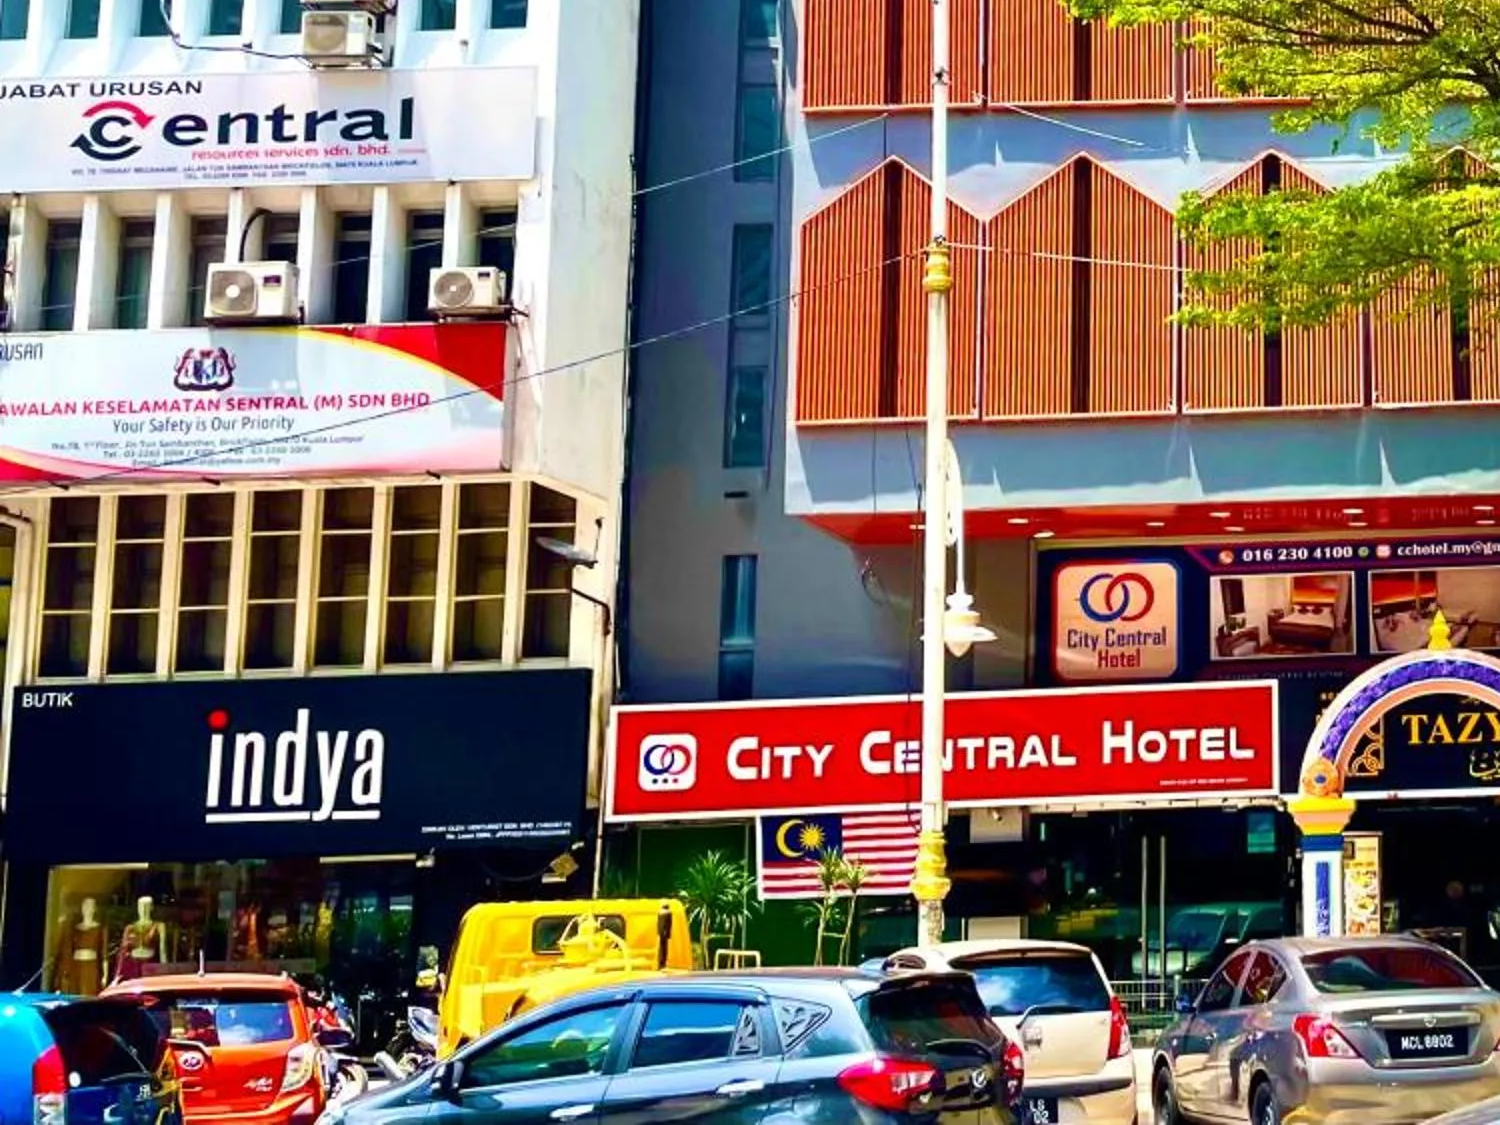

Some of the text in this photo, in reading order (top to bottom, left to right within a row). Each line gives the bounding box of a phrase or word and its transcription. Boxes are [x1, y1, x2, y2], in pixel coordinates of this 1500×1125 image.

[89, 80, 202, 97] URUSAN
[82, 398, 220, 415] KESELAMATAN
[226, 394, 309, 412] SENTRAL
[313, 394, 343, 412] (M)
[348, 393, 385, 408] SDN
[391, 392, 430, 407] BHD
[113, 415, 295, 435] Your Safety is Our Priority
[1242, 548, 1273, 563] 016
[1277, 547, 1308, 562] 230
[1313, 546, 1353, 560] 4100
[1067, 626, 1167, 652] City Central
[1097, 648, 1141, 668] Hotel
[21, 692, 74, 708] BUTIK
[205, 708, 386, 821] indya
